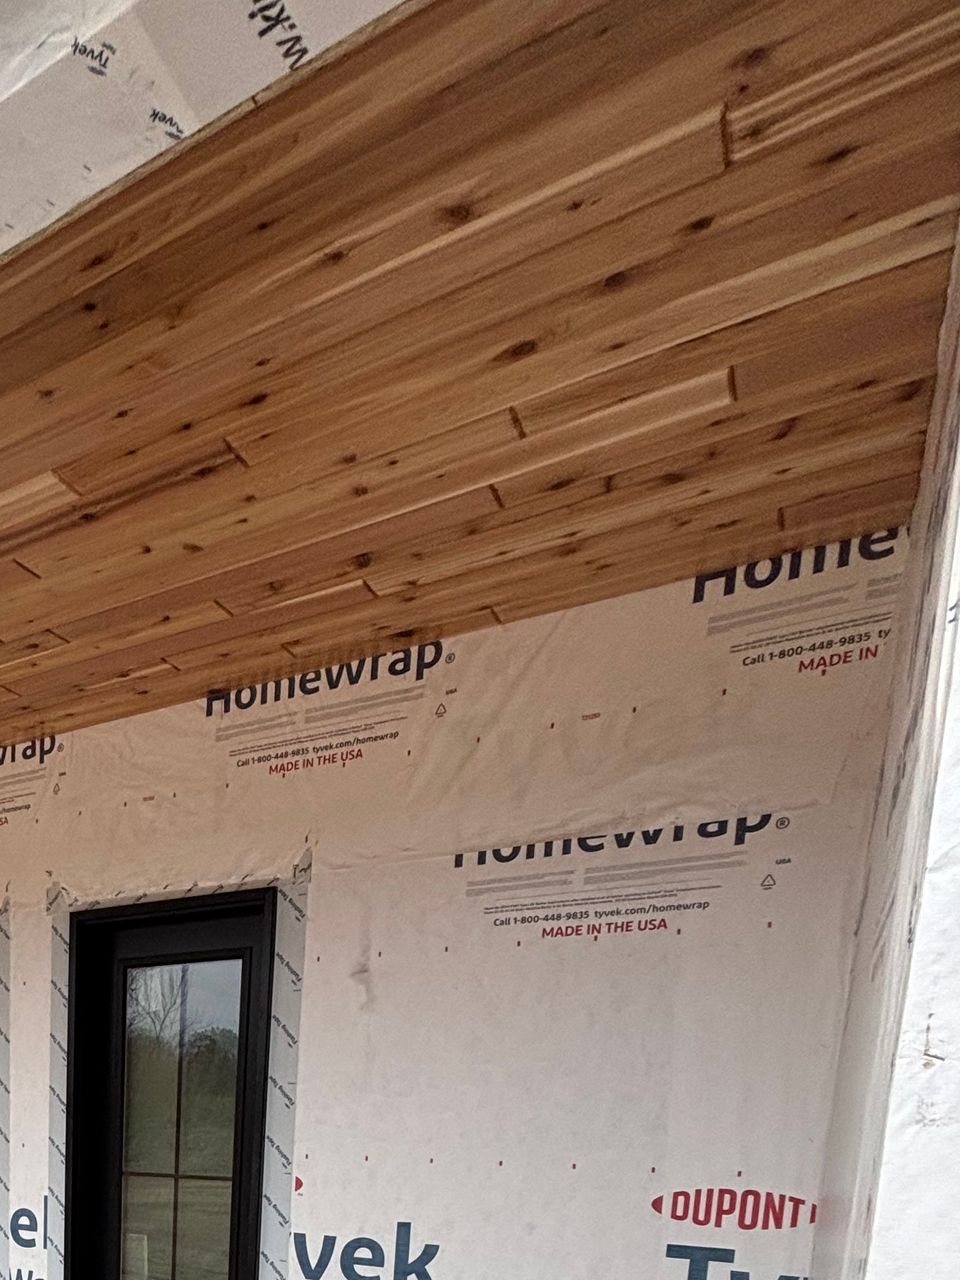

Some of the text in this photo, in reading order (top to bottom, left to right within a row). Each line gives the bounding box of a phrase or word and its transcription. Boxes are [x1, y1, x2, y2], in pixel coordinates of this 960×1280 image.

[71, 37, 109, 68] Tyvek
[742, 654, 764, 667] Call
[769, 633, 871, 660] 1-800-448-9835
[799, 645, 878, 673] MADE IN
[237, 731, 399, 767] Call 1-800-448-9835 tyvek.com/homewrap
[269, 749, 363, 775] MADE IN THE USA
[493, 901, 710, 926] Call 1-800-448-9835 tyvek.com/homewrap
[541, 918, 668, 938] MADE IN THE USA
[671, 1188, 805, 1230] DUPONT
